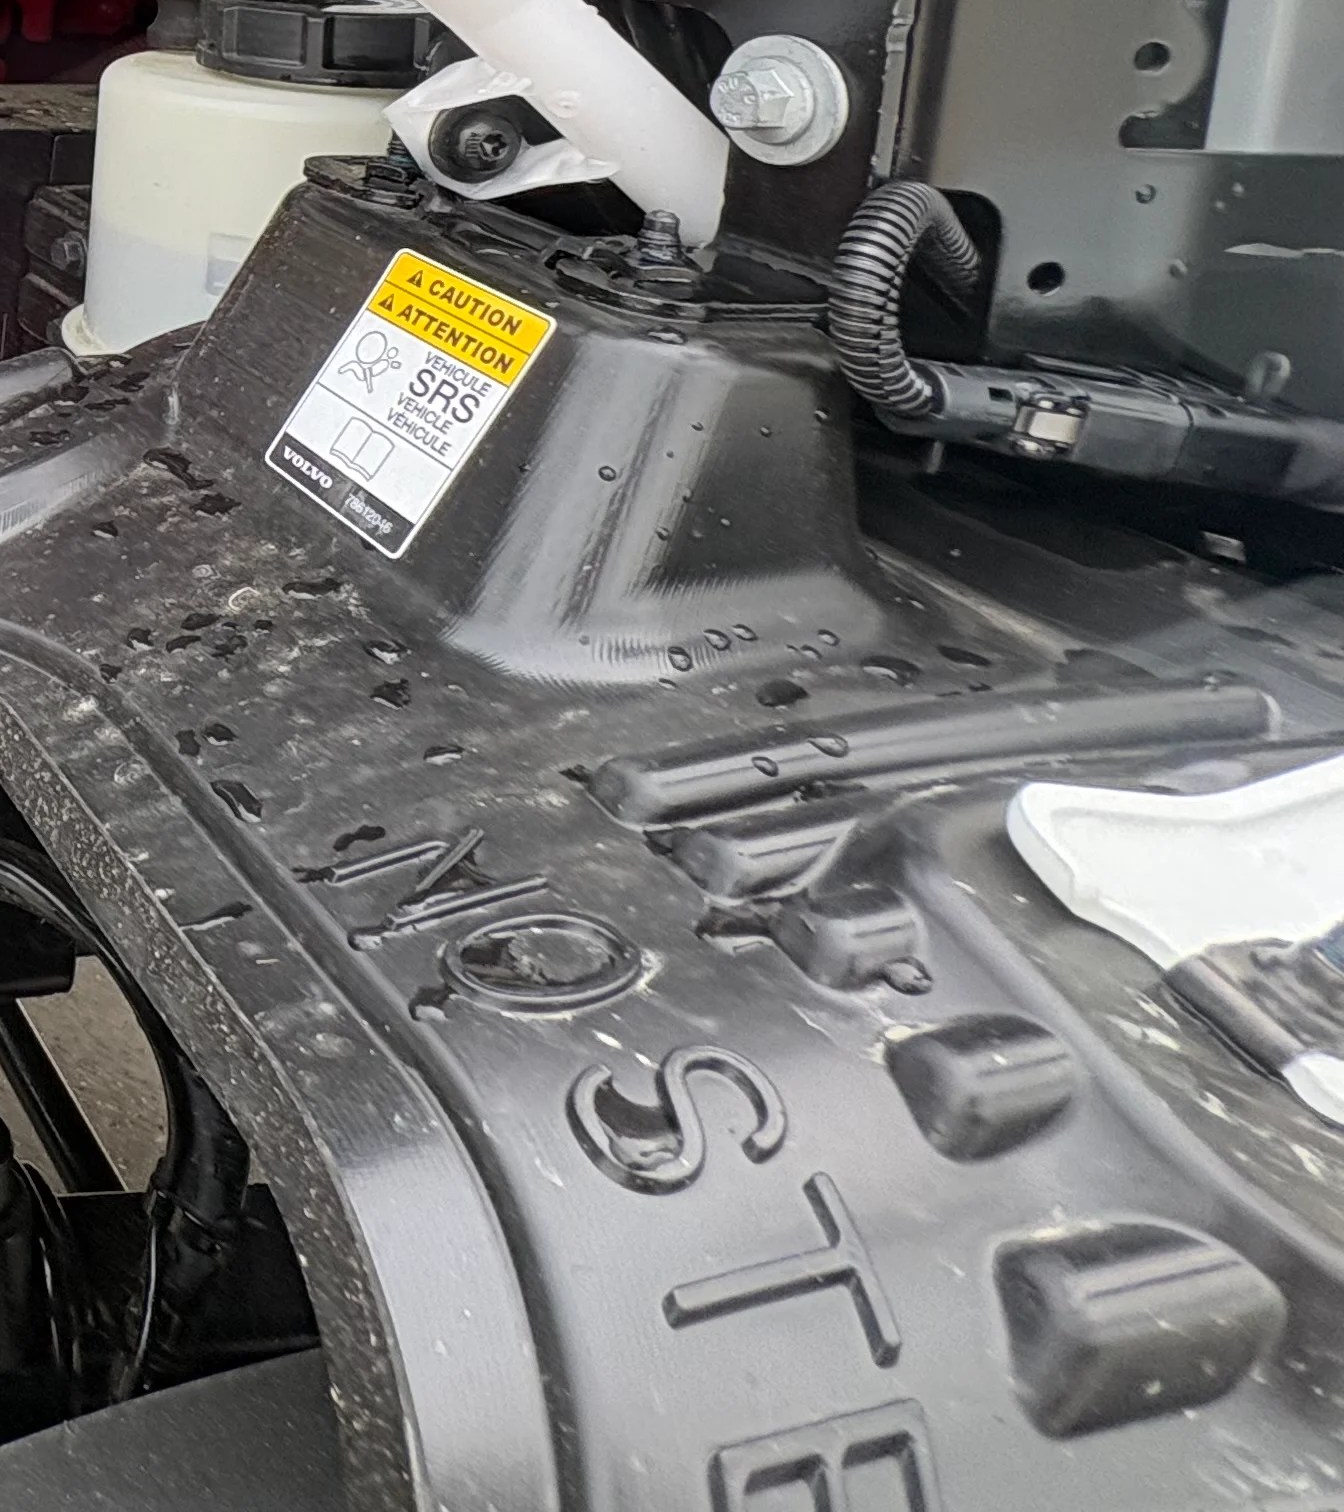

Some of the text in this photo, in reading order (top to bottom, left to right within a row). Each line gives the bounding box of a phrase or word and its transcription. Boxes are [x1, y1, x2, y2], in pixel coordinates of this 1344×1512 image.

[429, 279, 523, 337] CAUTION
[397, 303, 515, 375] ATTENTION
[408, 368, 481, 425] SRS
[424, 351, 493, 398] VEHICULE
[396, 391, 454, 435] VEHICLE
[282, 445, 335, 492] VOLVO
[325, 825, 647, 1015] NO
